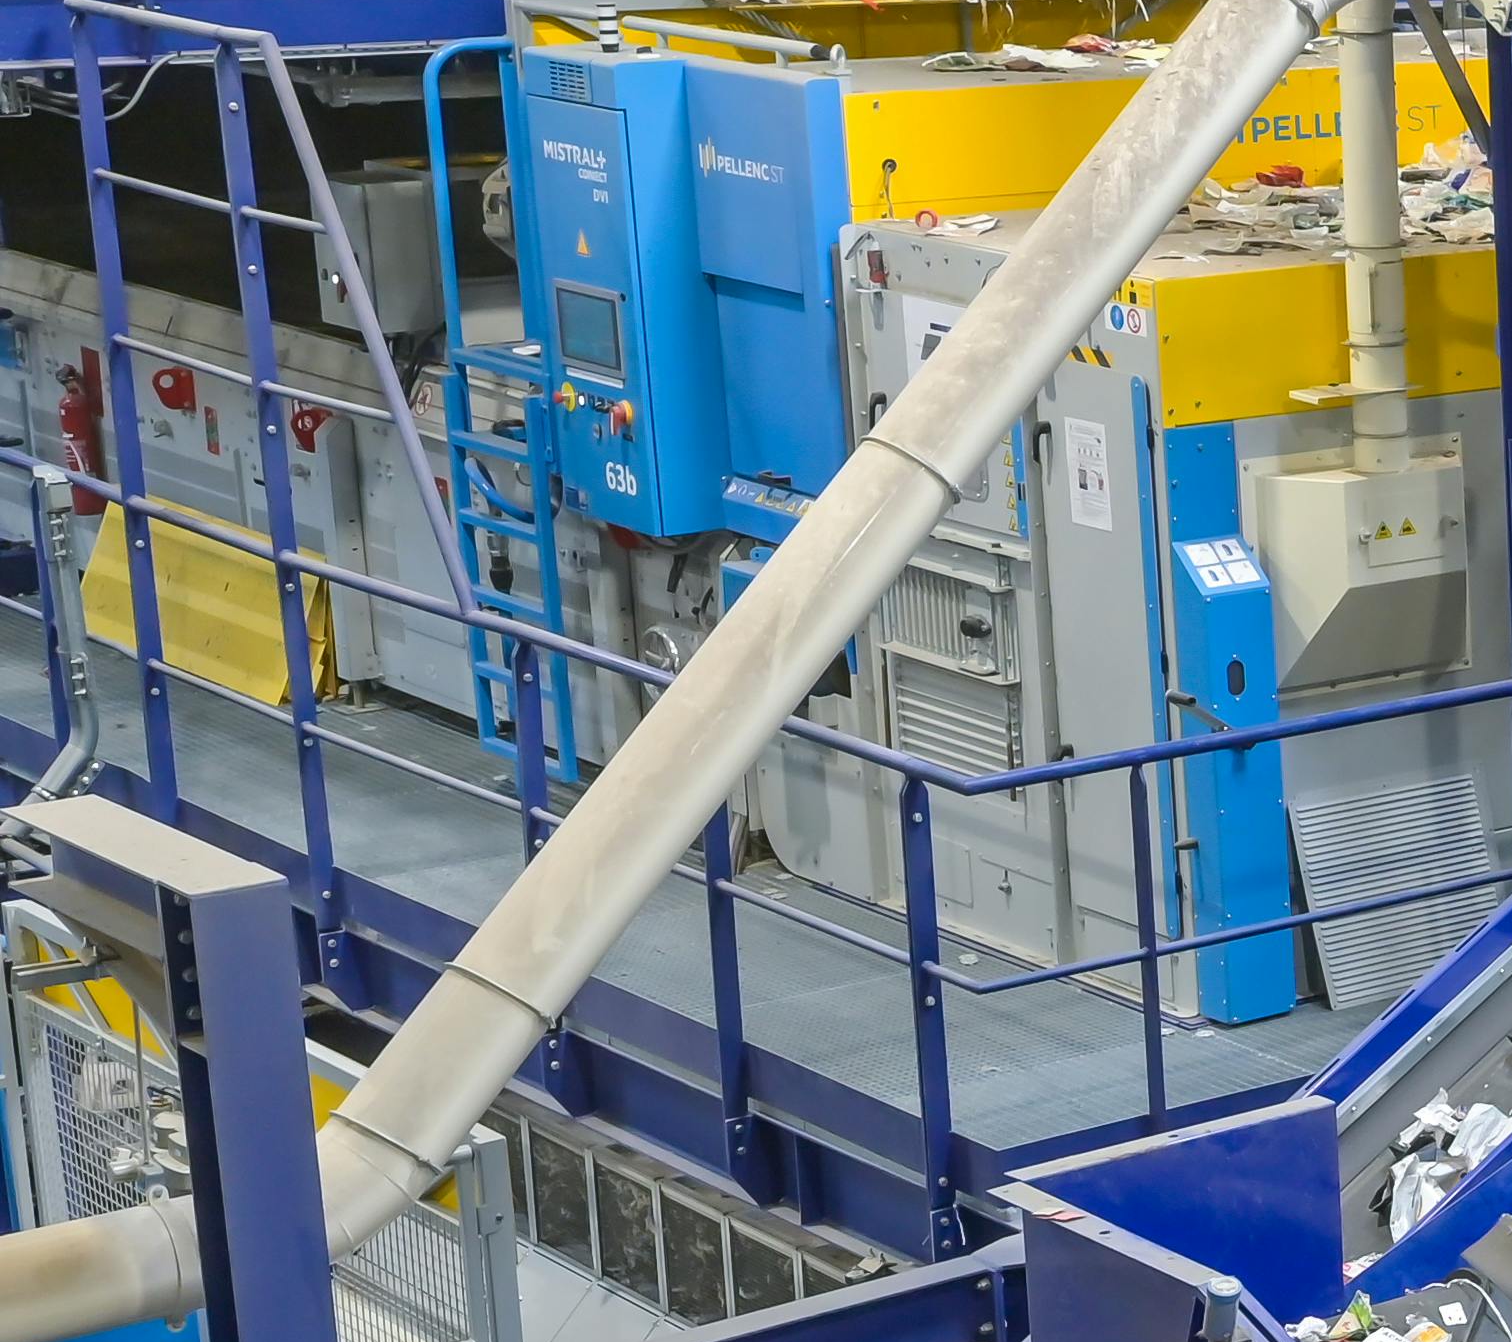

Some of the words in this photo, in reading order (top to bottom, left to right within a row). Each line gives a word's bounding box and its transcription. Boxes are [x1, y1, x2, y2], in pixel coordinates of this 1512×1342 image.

[1407, 105, 1442, 132] ST
[717, 155, 770, 181] PELLENC
[770, 166, 785, 184] ST
[605, 461, 637, 496] 63b
